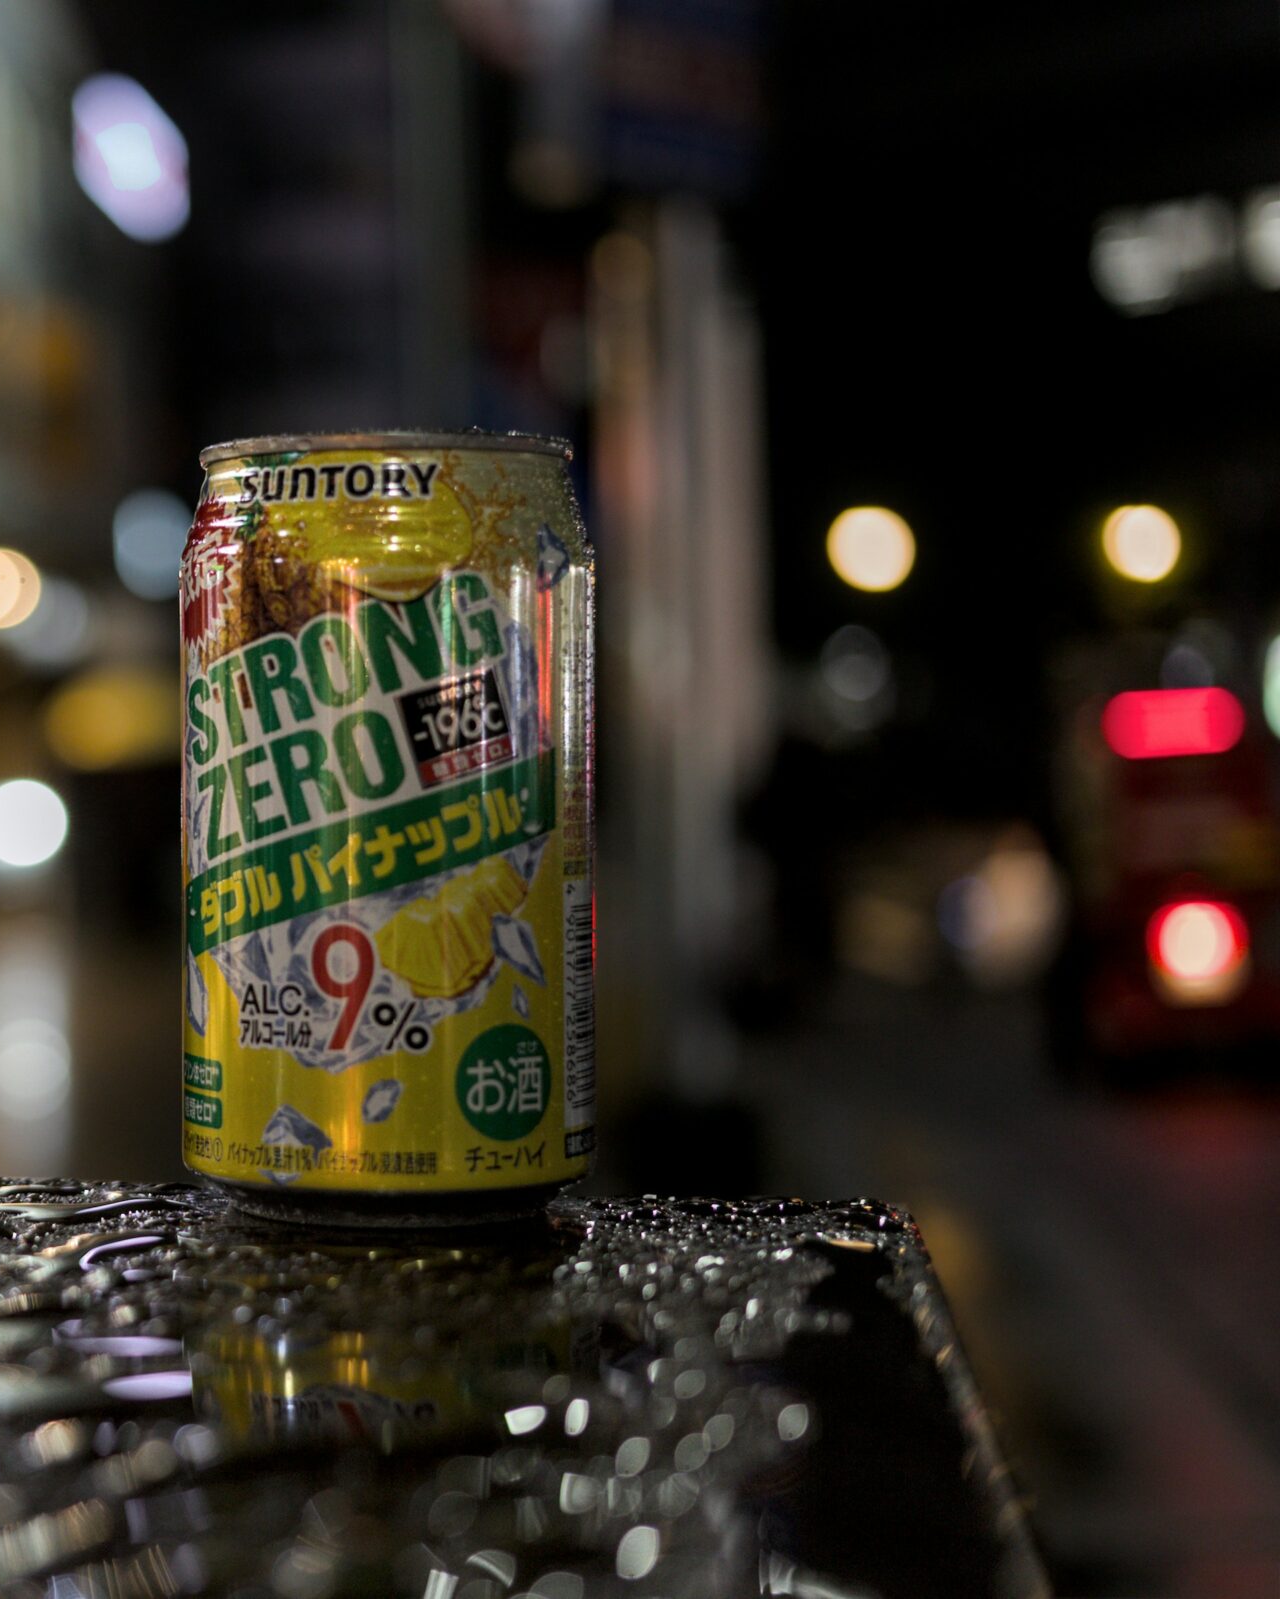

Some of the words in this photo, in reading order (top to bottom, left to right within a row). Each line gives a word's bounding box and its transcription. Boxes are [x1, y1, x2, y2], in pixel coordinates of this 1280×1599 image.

[238, 463, 438, 504] SUNTORY
[188, 573, 502, 766] STRONG
[197, 711, 406, 860] ZERO
[200, 865, 282, 936] ダブル
[291, 788, 520, 902] パイナップル
[241, 984, 310, 1017] ALC.
[240, 1020, 312, 1049] アルコール分
[466, 1055, 543, 1114] お酒
[464, 1141, 546, 1173] チューハイ
